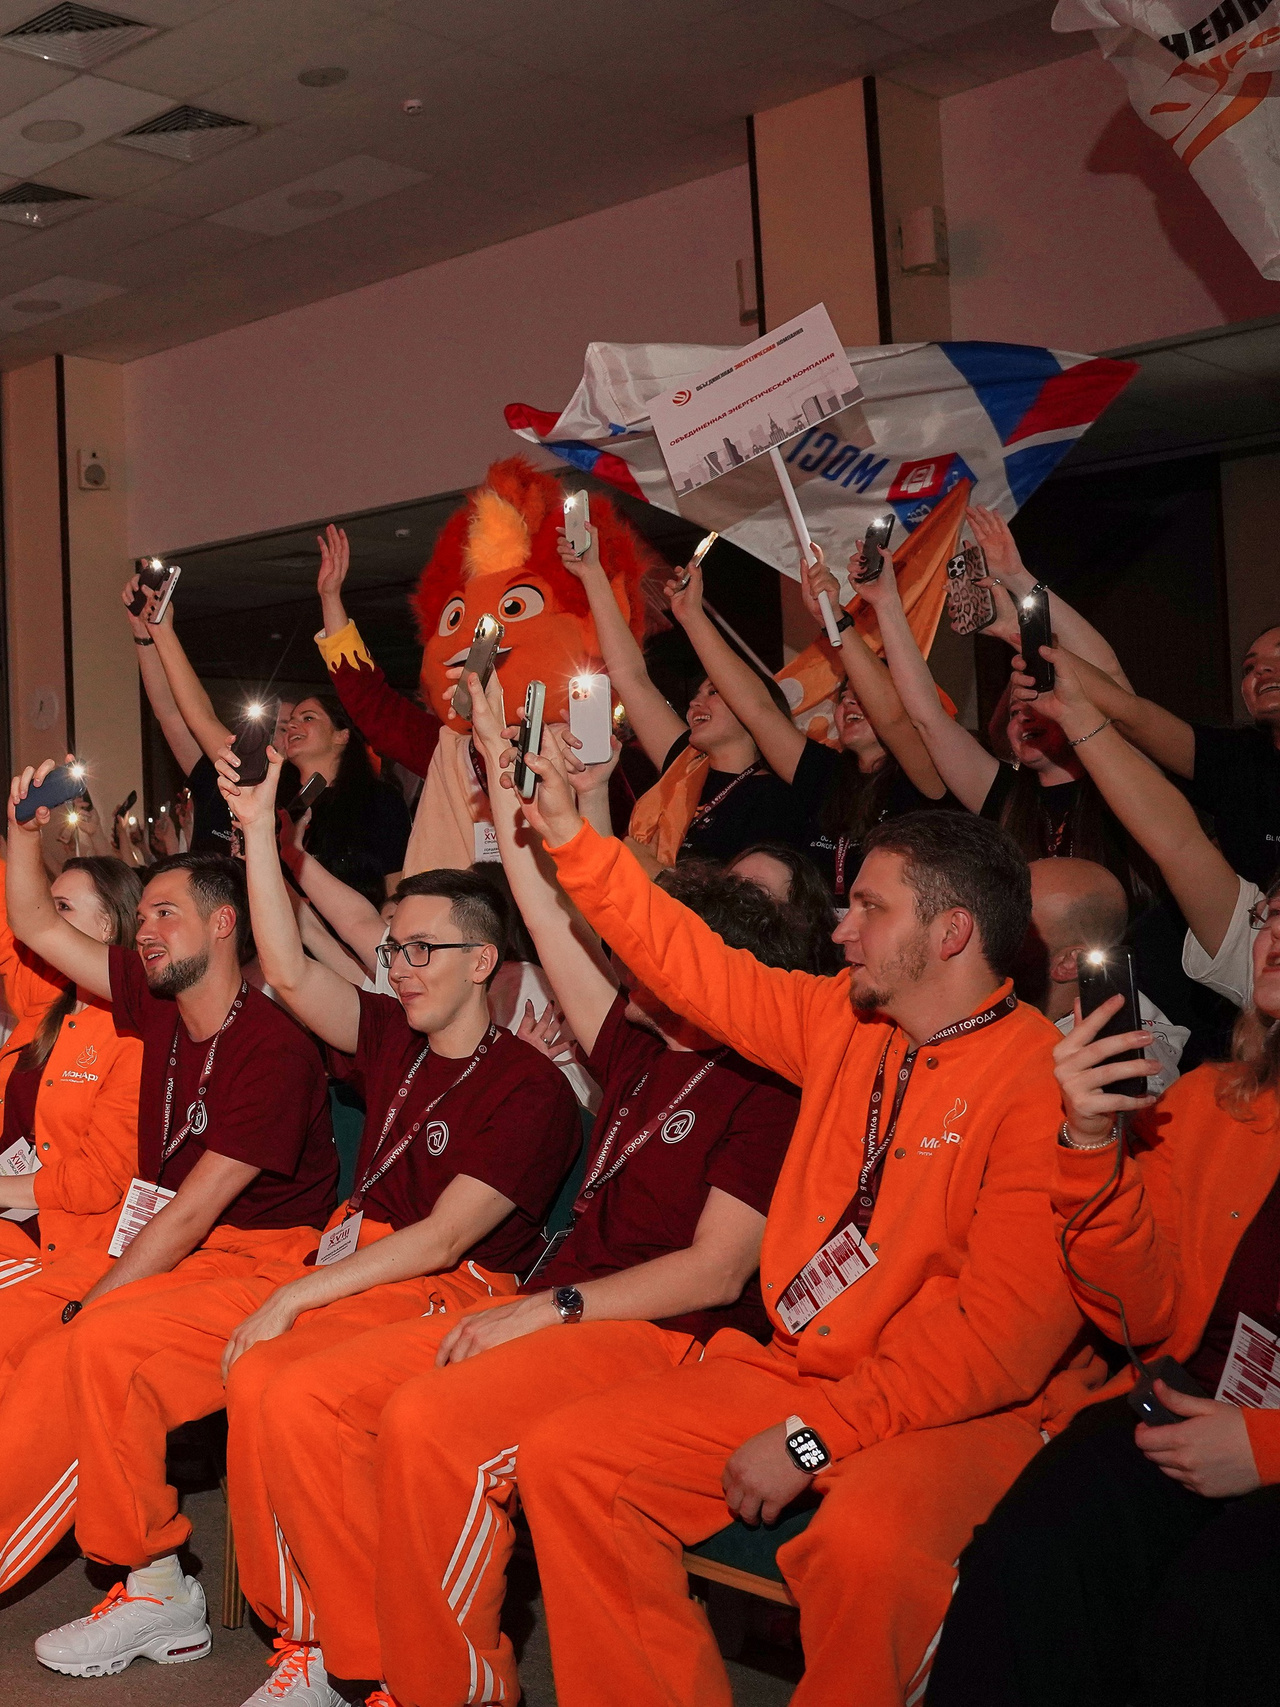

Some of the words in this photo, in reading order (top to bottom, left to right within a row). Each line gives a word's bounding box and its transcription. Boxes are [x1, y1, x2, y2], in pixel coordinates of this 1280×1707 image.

[669, 412, 727, 447] ОБЪЕДИНЕННАЯ
[727, 376, 792, 415] ЭНЕРГЕТИЧЕСКАЯ
[792, 352, 836, 379] КОМПАНИЯ
[959, 1010, 997, 1031] ГОРОДА
[204, 1048, 215, 1075] ГОРОДА
[166, 1077, 174, 1103] ГОРОДА
[673, 1068, 707, 1105] ФУНДАМЕНТ
[382, 1107, 396, 1135] ГОРОДА
[379, 1139, 409, 1173] ФУНДАМЕНТ
[597, 1126, 618, 1171] ФУНДАМЕНТ
[626, 1130, 650, 1156] ГОРОДА
[10, 1153, 27, 1173] XVIII
[860, 1138, 890, 1185] ФУНДАМЕНТ
[360, 1169, 382, 1193] ГОРОДА
